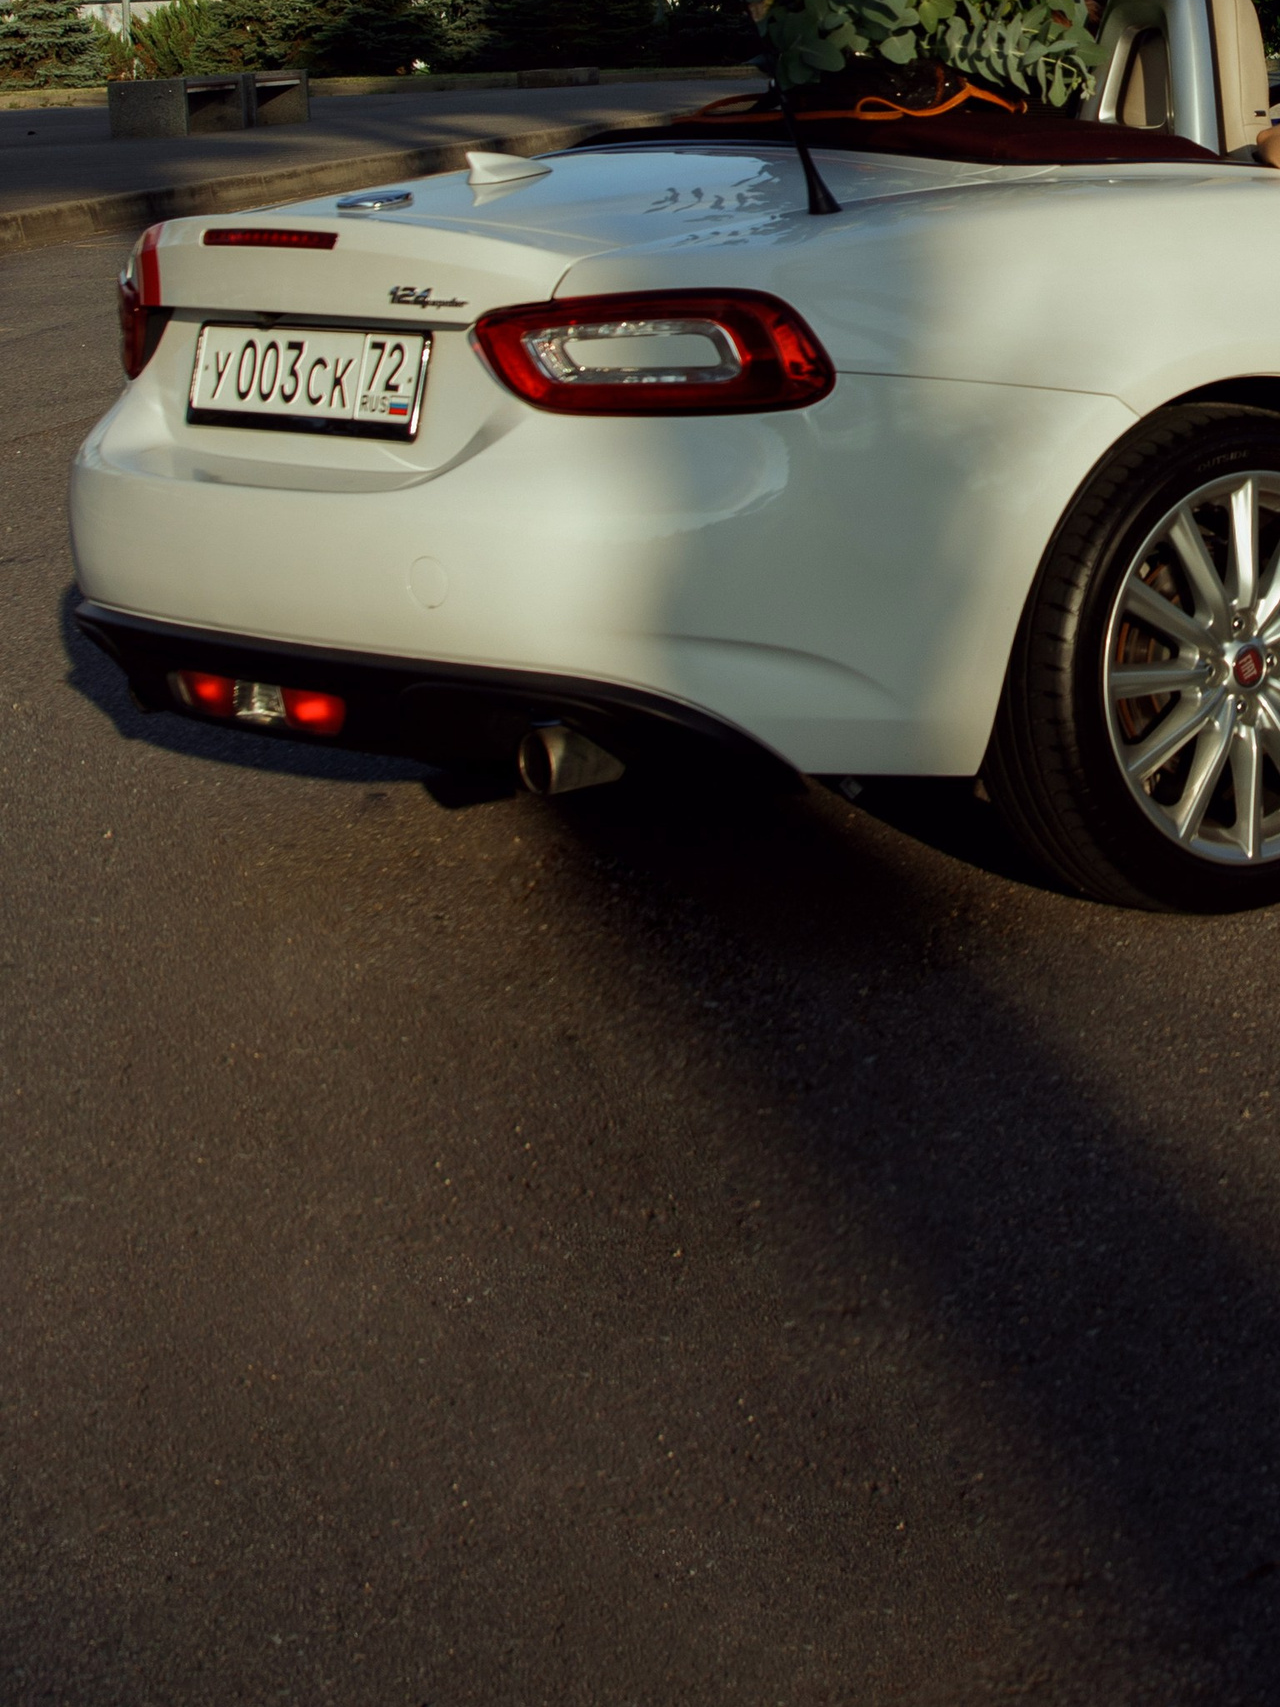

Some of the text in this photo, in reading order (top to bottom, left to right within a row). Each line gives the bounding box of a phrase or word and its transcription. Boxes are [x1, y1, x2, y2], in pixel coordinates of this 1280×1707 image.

[388, 286, 432, 309] 124
[367, 341, 405, 392] 72
[359, 394, 389, 413] RUS
[1239, 654, 1257, 680] FIAT
